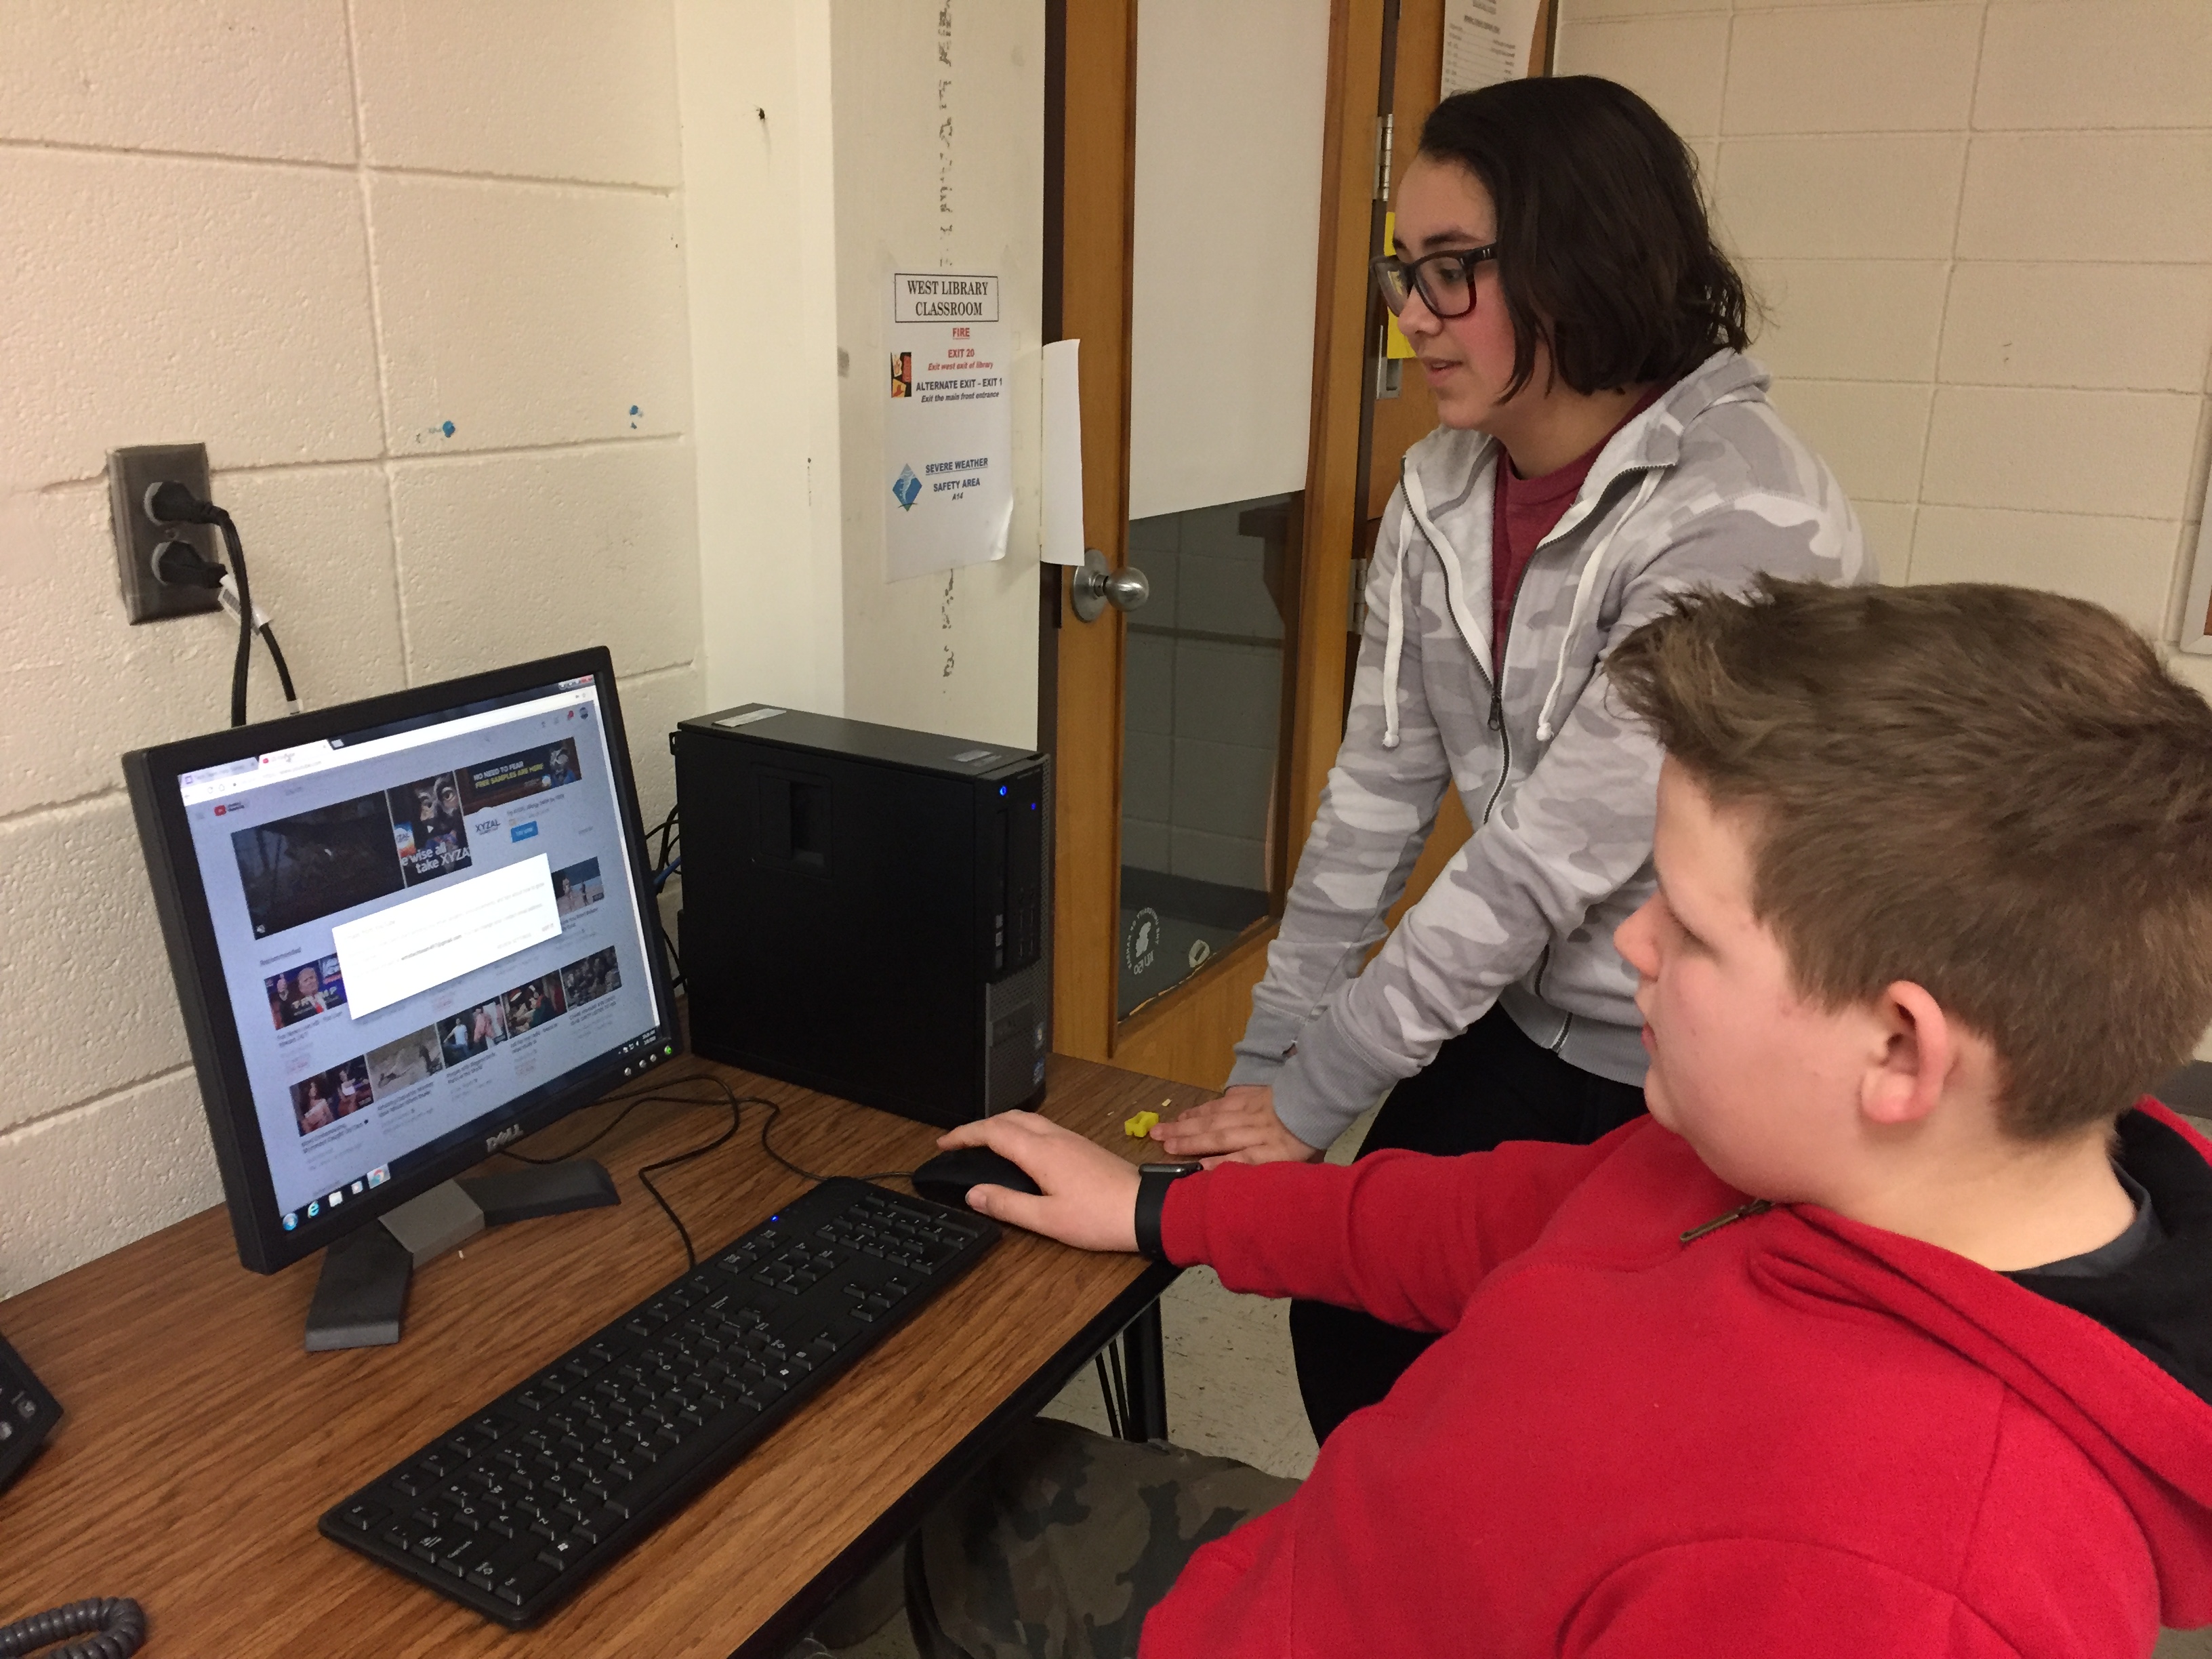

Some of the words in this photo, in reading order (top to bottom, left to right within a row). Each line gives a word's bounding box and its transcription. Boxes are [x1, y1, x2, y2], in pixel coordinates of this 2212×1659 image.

[907, 280, 939, 294] WEST
[941, 281, 988, 295] LIBRARY
[916, 302, 983, 316] CLASSROOM
[952, 327, 970, 337] FIRE
[948, 349, 964, 358] EXIT
[966, 348, 975, 357] 20
[928, 363, 941, 371] Exit
[976, 361, 994, 369] library
[916, 380, 958, 391] ALTERNATE
[960, 379, 977, 388] EXIT
[982, 378, 998, 387] EXIT
[921, 394, 933, 403] Exit
[945, 393, 960, 401] main
[925, 462, 953, 473] SEVERE
[954, 457, 988, 469] WEATHER
[933, 480, 960, 492] SAFETY
[962, 478, 981, 488] AREA
[473, 773, 483, 781] NO
[509, 760, 524, 770] FEAR
[475, 819, 501, 832] XYZAL
[409, 849, 433, 863] wise
[415, 859, 439, 874] take
[485, 1124, 524, 1152] DELL
